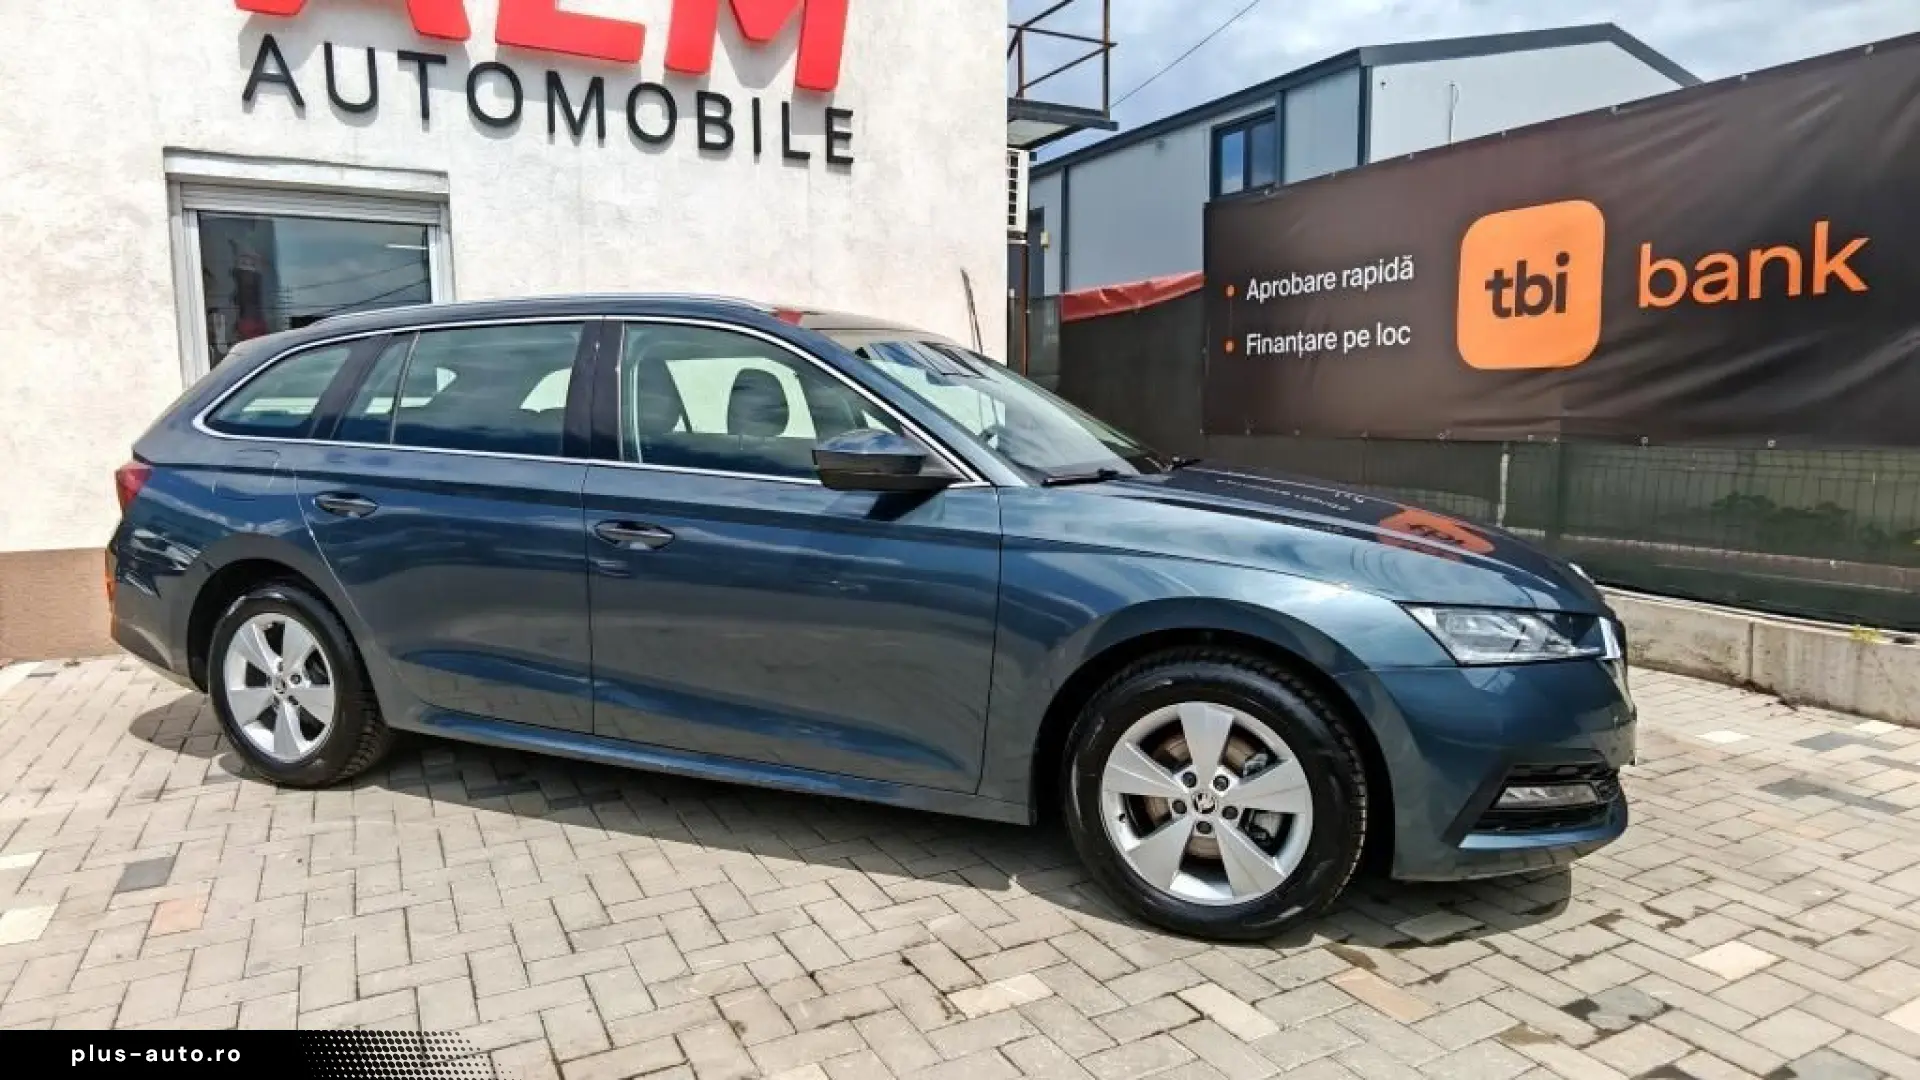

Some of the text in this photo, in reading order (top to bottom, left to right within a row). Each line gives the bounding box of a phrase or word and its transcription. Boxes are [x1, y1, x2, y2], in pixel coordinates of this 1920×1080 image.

[242, 34, 854, 164] AUTOMOBILE
[1246, 255, 1414, 304] Aprobare rapidă
[1484, 220, 1871, 319] tbi bank
[1344, 329, 1370, 354] pe
[1375, 321, 1411, 347] loc
